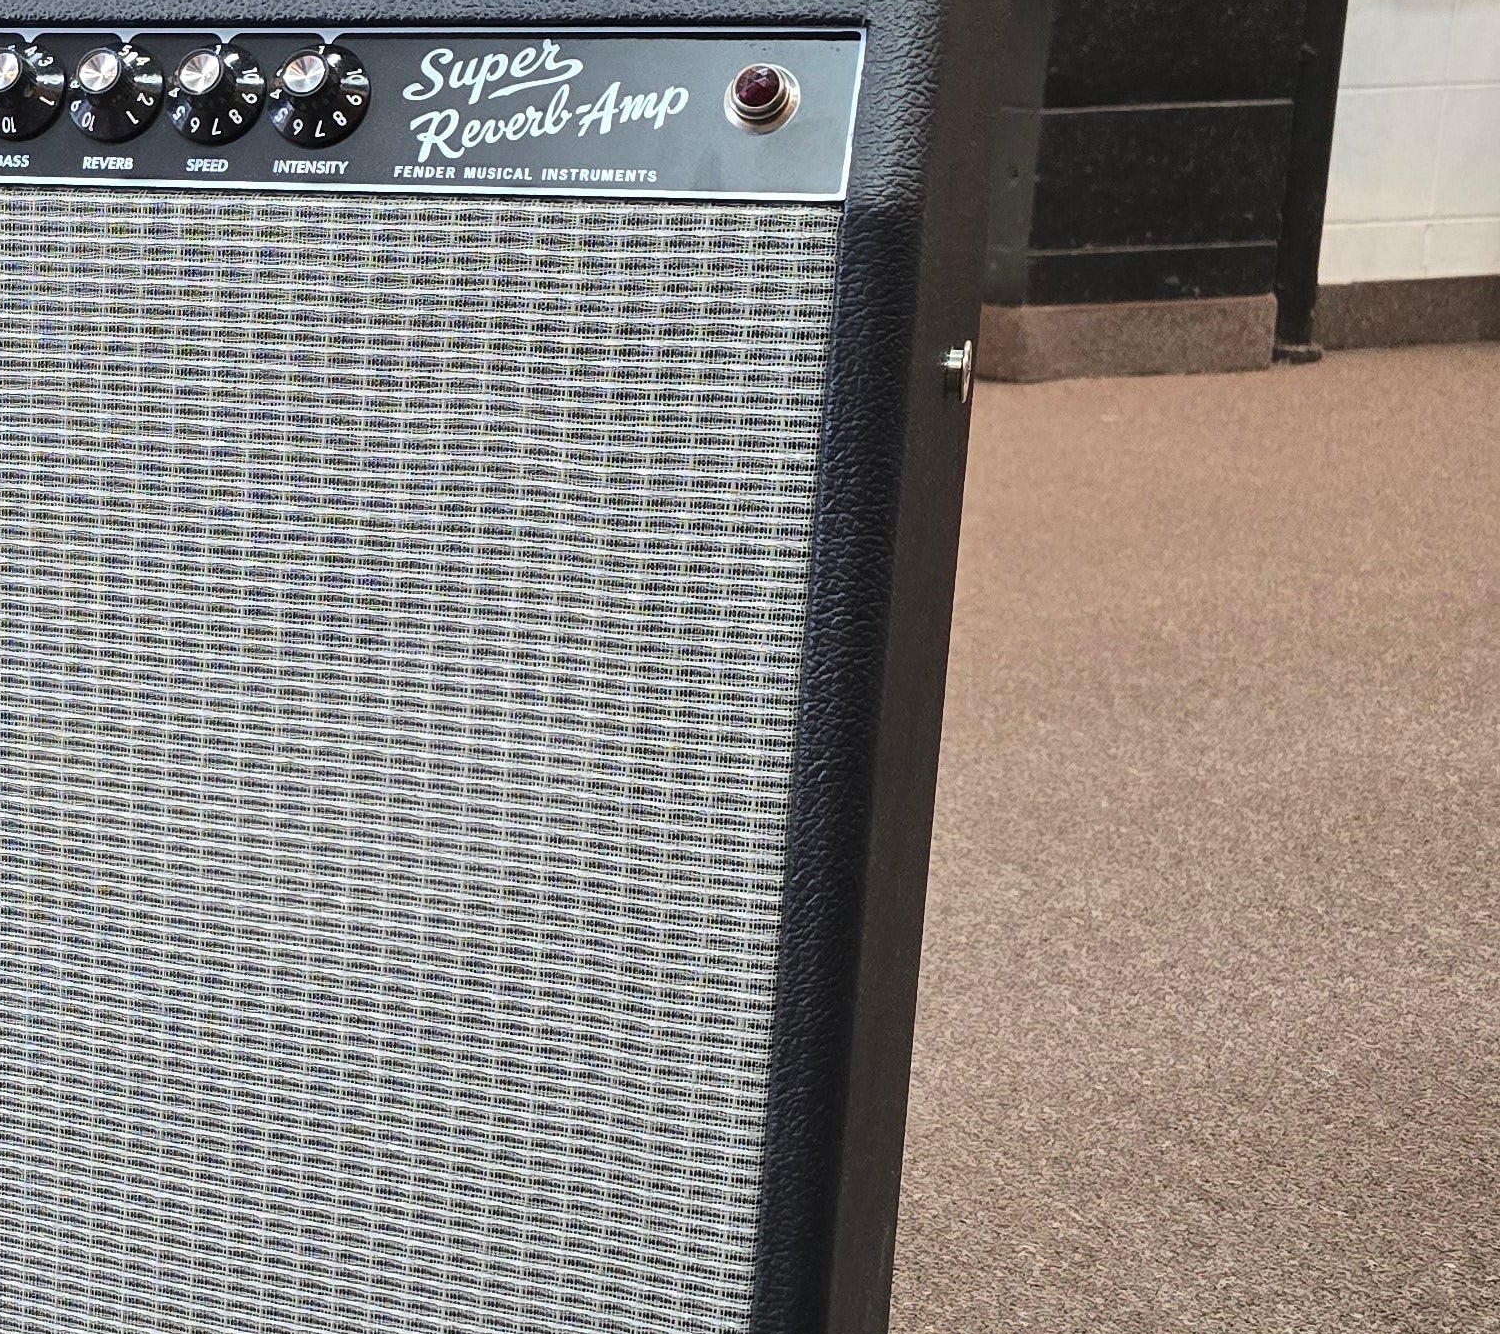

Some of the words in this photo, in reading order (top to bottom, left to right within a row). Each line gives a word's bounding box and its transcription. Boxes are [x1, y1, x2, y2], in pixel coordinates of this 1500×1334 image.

[402, 39, 584, 105] Super
[229, 109, 243, 124] 8
[332, 111, 347, 126] 8
[410, 81, 690, 163] Reverb-Amp
[83, 156, 134, 170] REVERB
[186, 158, 229, 172] SPEED
[272, 160, 349, 175] INTENSITY
[393, 165, 456, 179] FENDER
[463, 167, 533, 181] MUSICAL
[541, 168, 658, 183] INSTRUMENTS
